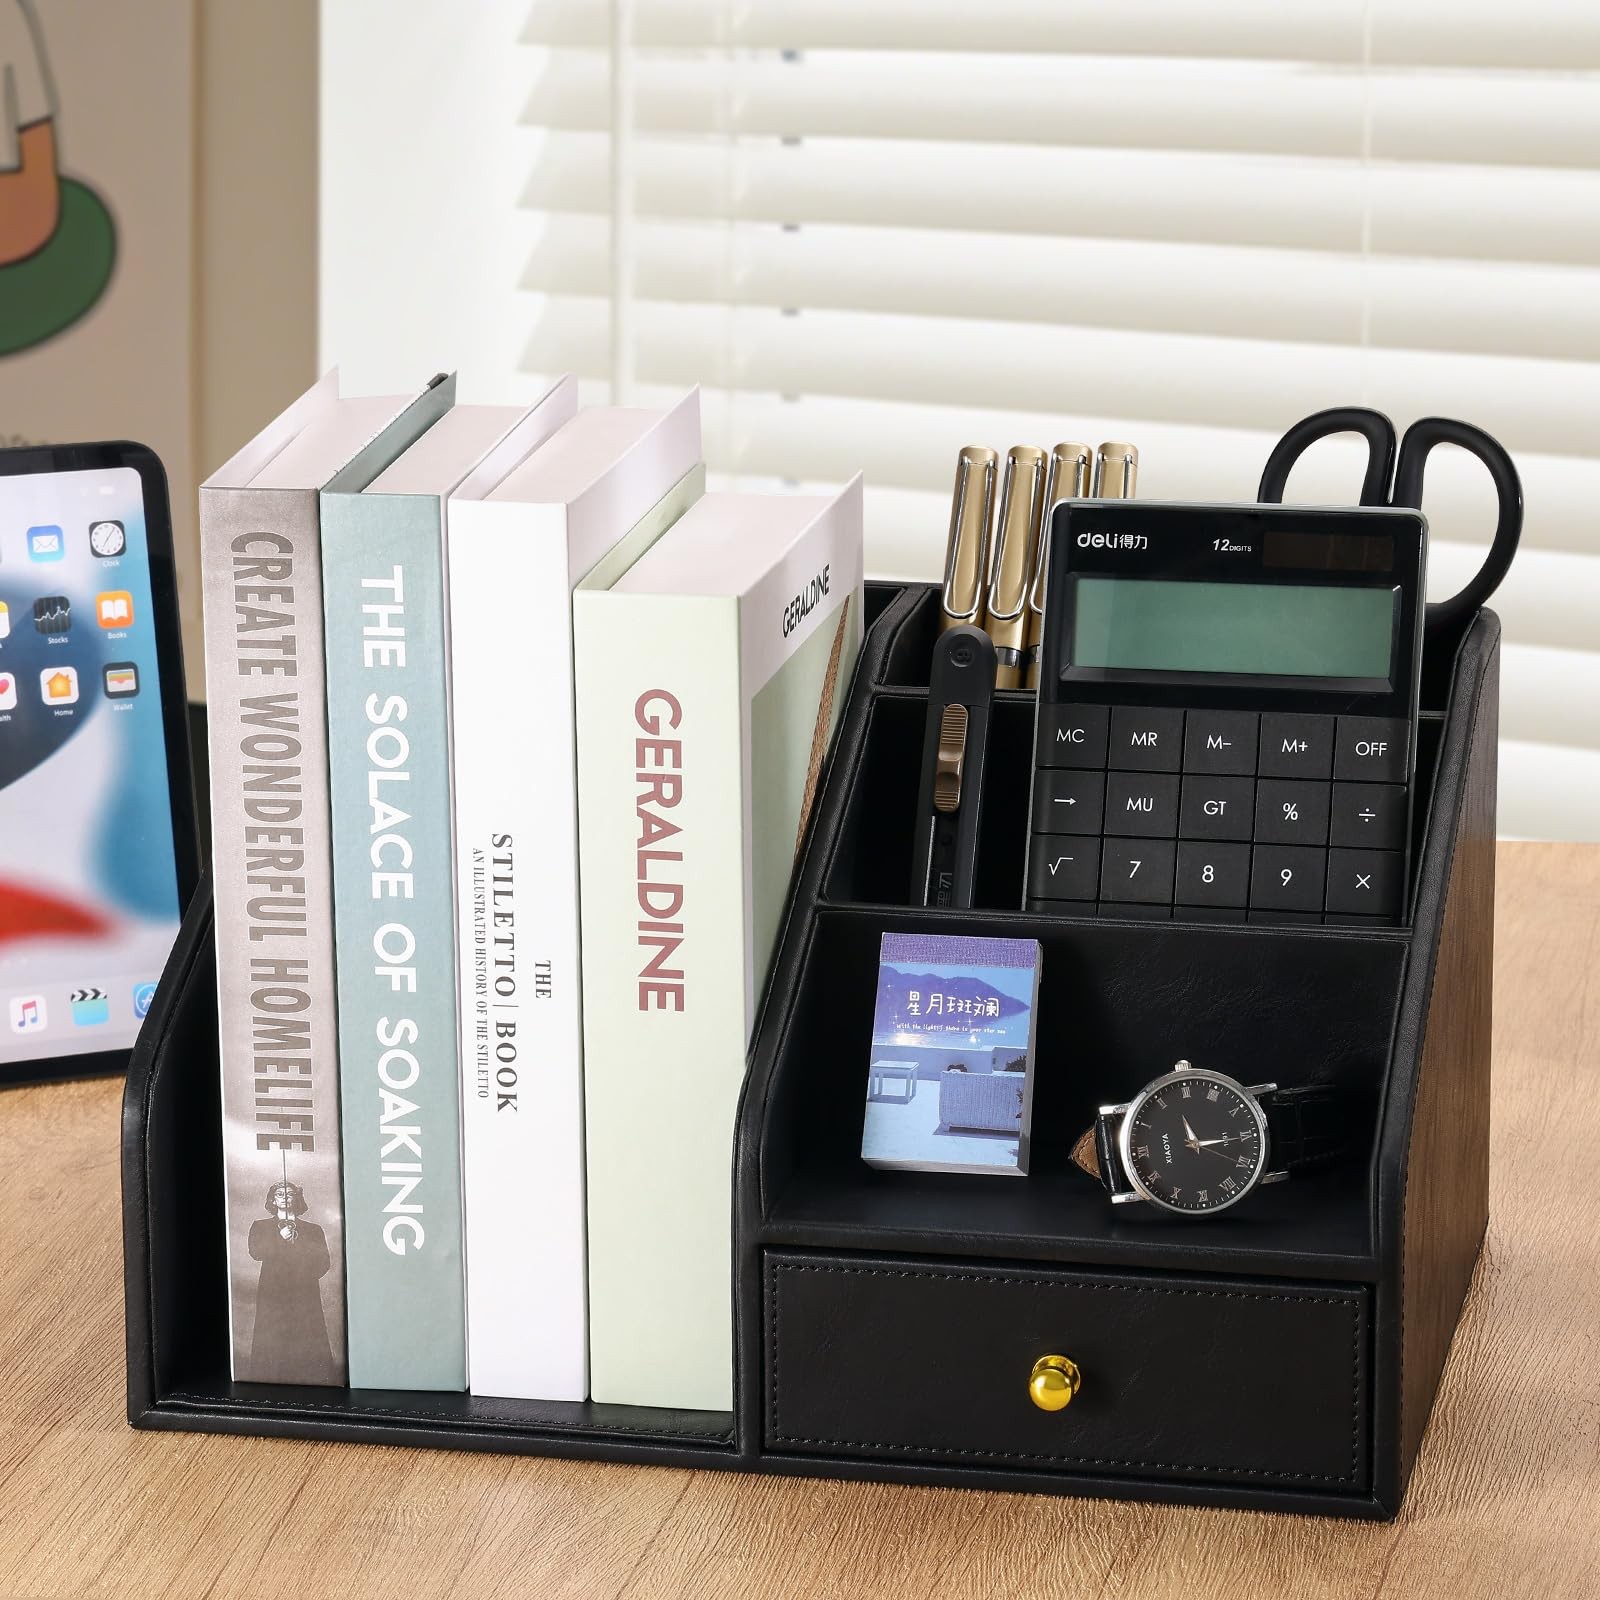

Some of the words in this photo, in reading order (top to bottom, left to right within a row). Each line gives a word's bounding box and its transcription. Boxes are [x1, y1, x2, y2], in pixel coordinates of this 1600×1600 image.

[103, 560, 120, 568] Clock
[231, 532, 298, 677] CREATE
[361, 564, 406, 668] THE
[782, 564, 830, 638] GERALDINE
[48, 636, 68, 644] Stocks
[1056, 728, 1085, 744] MC
[1131, 732, 1158, 747] MR
[1282, 738, 1308, 754] M+
[1355, 742, 1388, 757] OFF
[365, 692, 414, 899] SOLACE
[1126, 797, 1154, 812] MU
[1203, 801, 1226, 816] GT
[239, 692, 308, 942] WONDERFUL
[472, 848, 484, 863] AN
[634, 688, 685, 1012] GERALDINE
[1128, 860, 1142, 878] 7
[1202, 864, 1214, 884] 8
[1280, 868, 1293, 887] 9
[474, 867, 486, 944] ILLUSTRATED
[492, 833, 516, 997] STILETTO
[373, 922, 417, 993] OF
[475, 948, 488, 996] HISTORY
[535, 960, 552, 998] THE
[476, 1000, 488, 1016] OF
[476, 1018, 488, 1040] THE
[250, 958, 315, 1153] HOMELIFE
[476, 1044, 489, 1098] STILETTO
[496, 1020, 518, 1112] BOOK
[376, 1016, 425, 1256] SOAKING
[1161, 1133, 1172, 1164] XIAOYA
